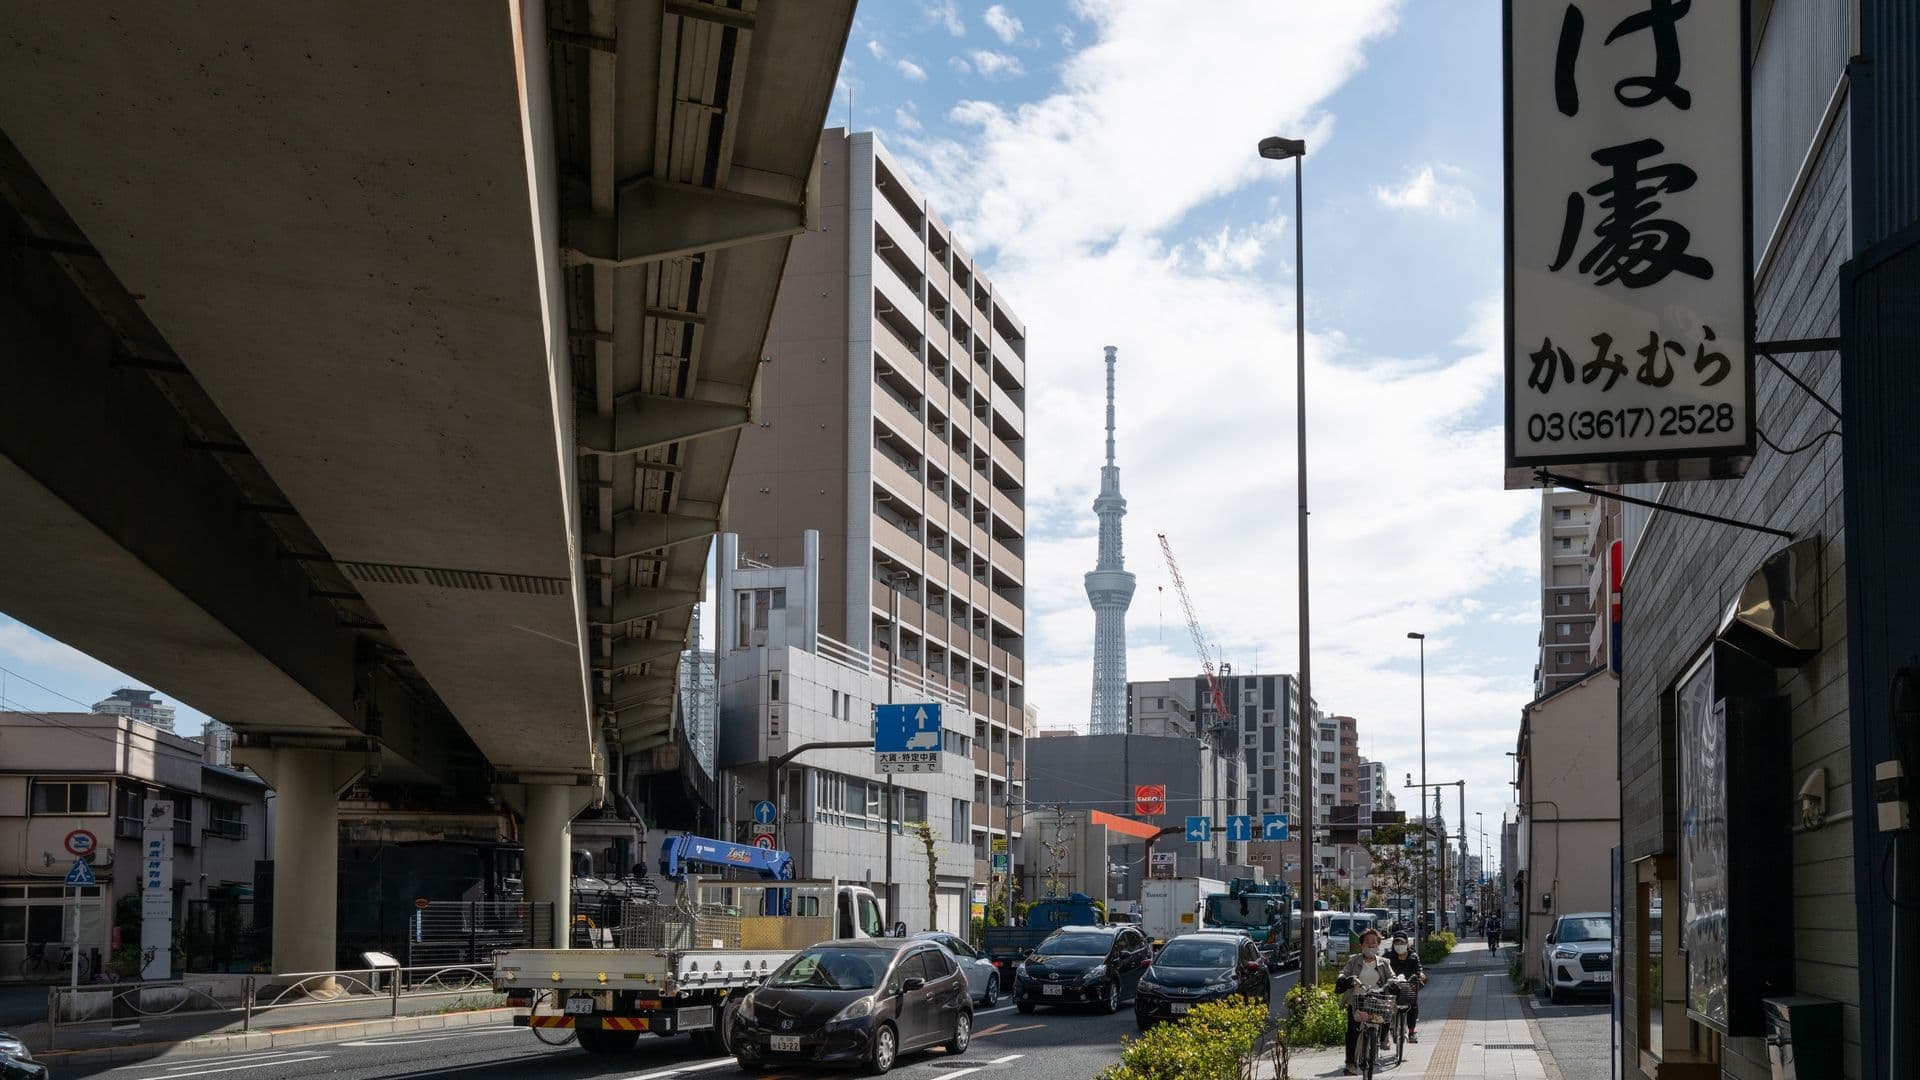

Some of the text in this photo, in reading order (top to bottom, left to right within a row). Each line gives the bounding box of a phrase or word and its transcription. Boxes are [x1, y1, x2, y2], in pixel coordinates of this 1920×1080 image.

[1527, 325, 1731, 395] かみむら
[1527, 403, 1735, 443] 03(3617)2528
[882, 764, 935, 773] ここまで
[777, 1042, 800, 1051] 13-22
